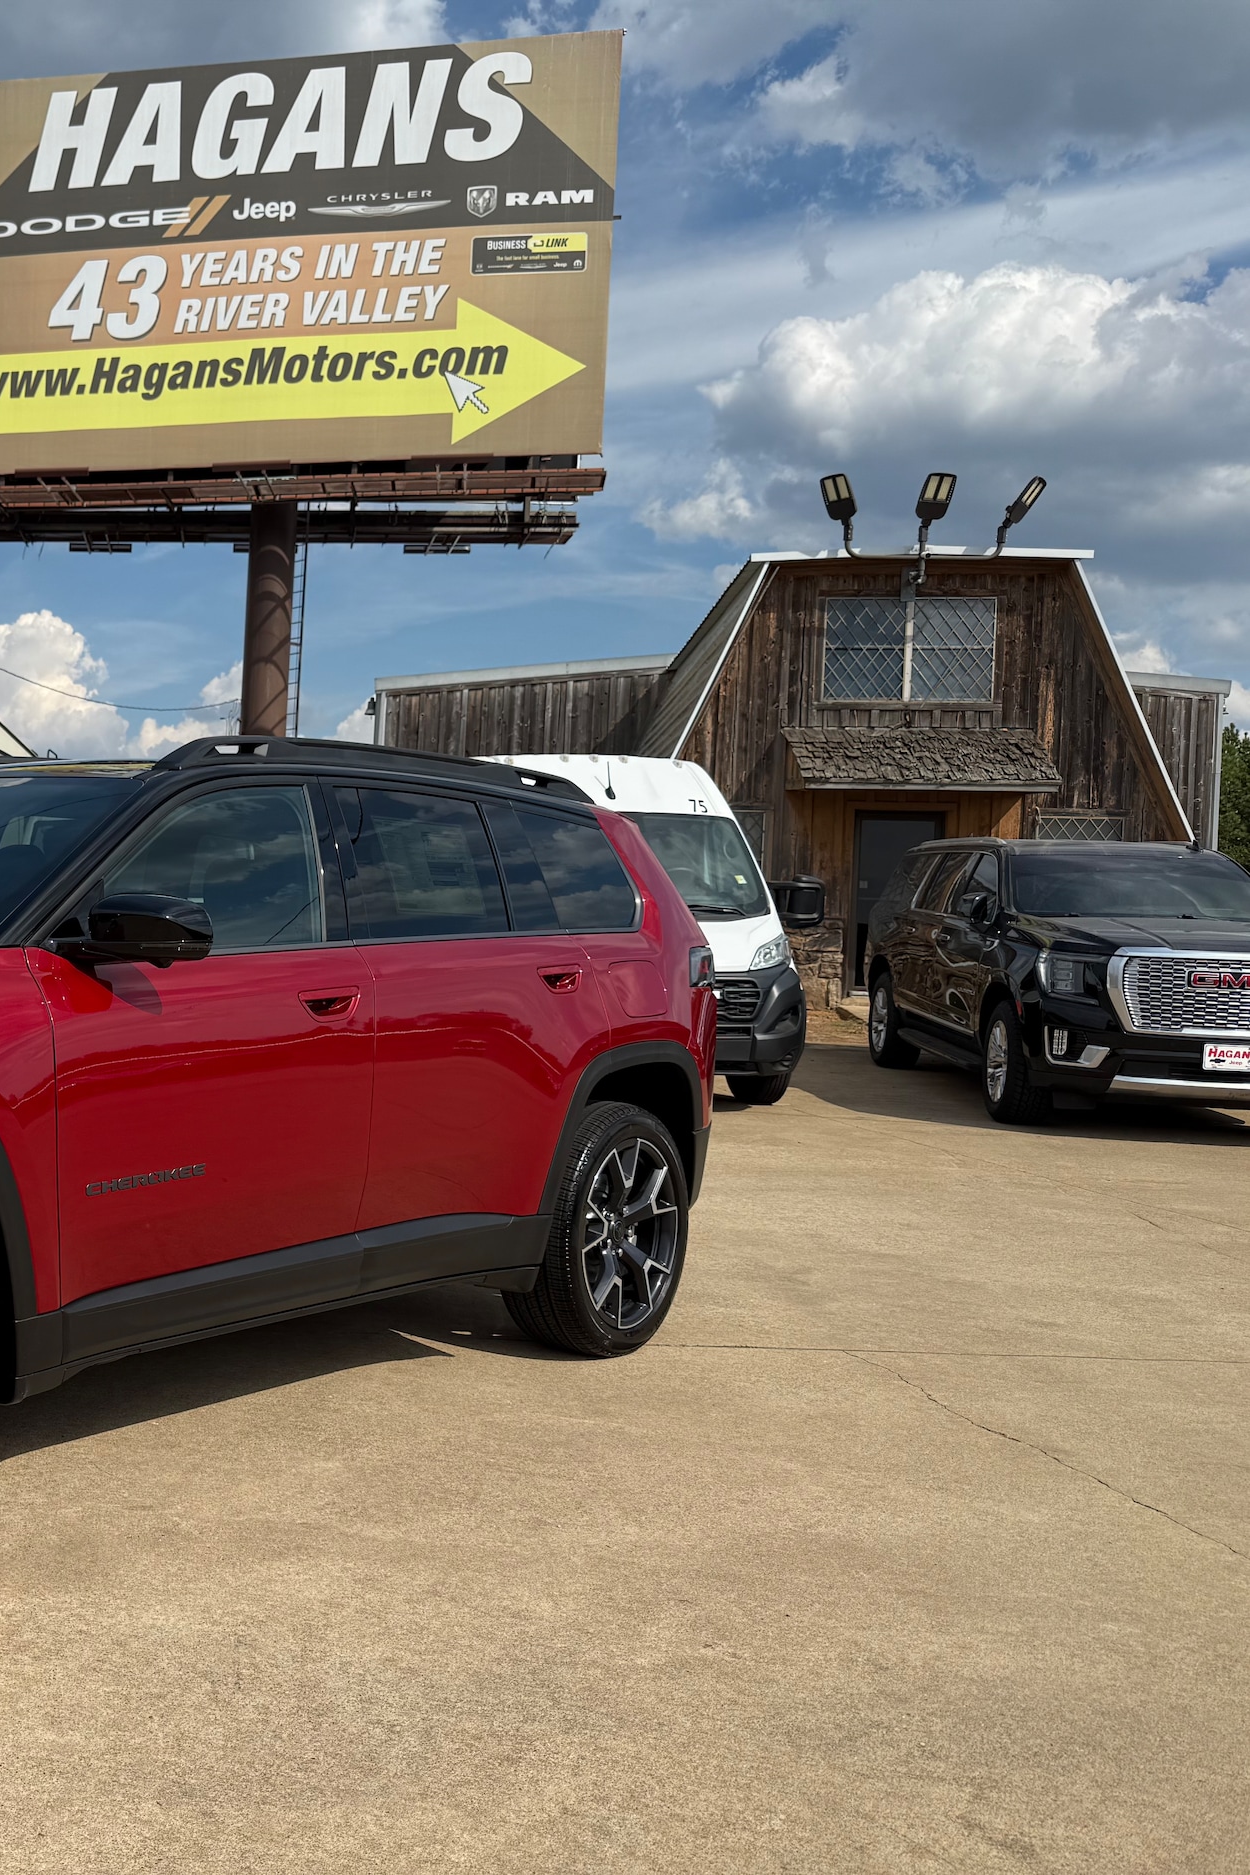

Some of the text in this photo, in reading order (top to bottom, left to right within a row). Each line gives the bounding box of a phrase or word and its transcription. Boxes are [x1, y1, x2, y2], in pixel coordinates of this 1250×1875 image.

[28, 51, 532, 192] HAGANS
[233, 198, 296, 222] Jeep
[327, 190, 432, 203] CHRYSLER
[505, 189, 594, 206] RAM
[487, 238, 569, 250] BUSINESS LINK
[180, 238, 447, 288] YEARS IN THE
[47, 254, 168, 341] 43
[173, 284, 450, 334] RIVER VALLEY
[688, 799, 708, 813] 75
[85, 1163, 206, 1197] CHEROKEE
